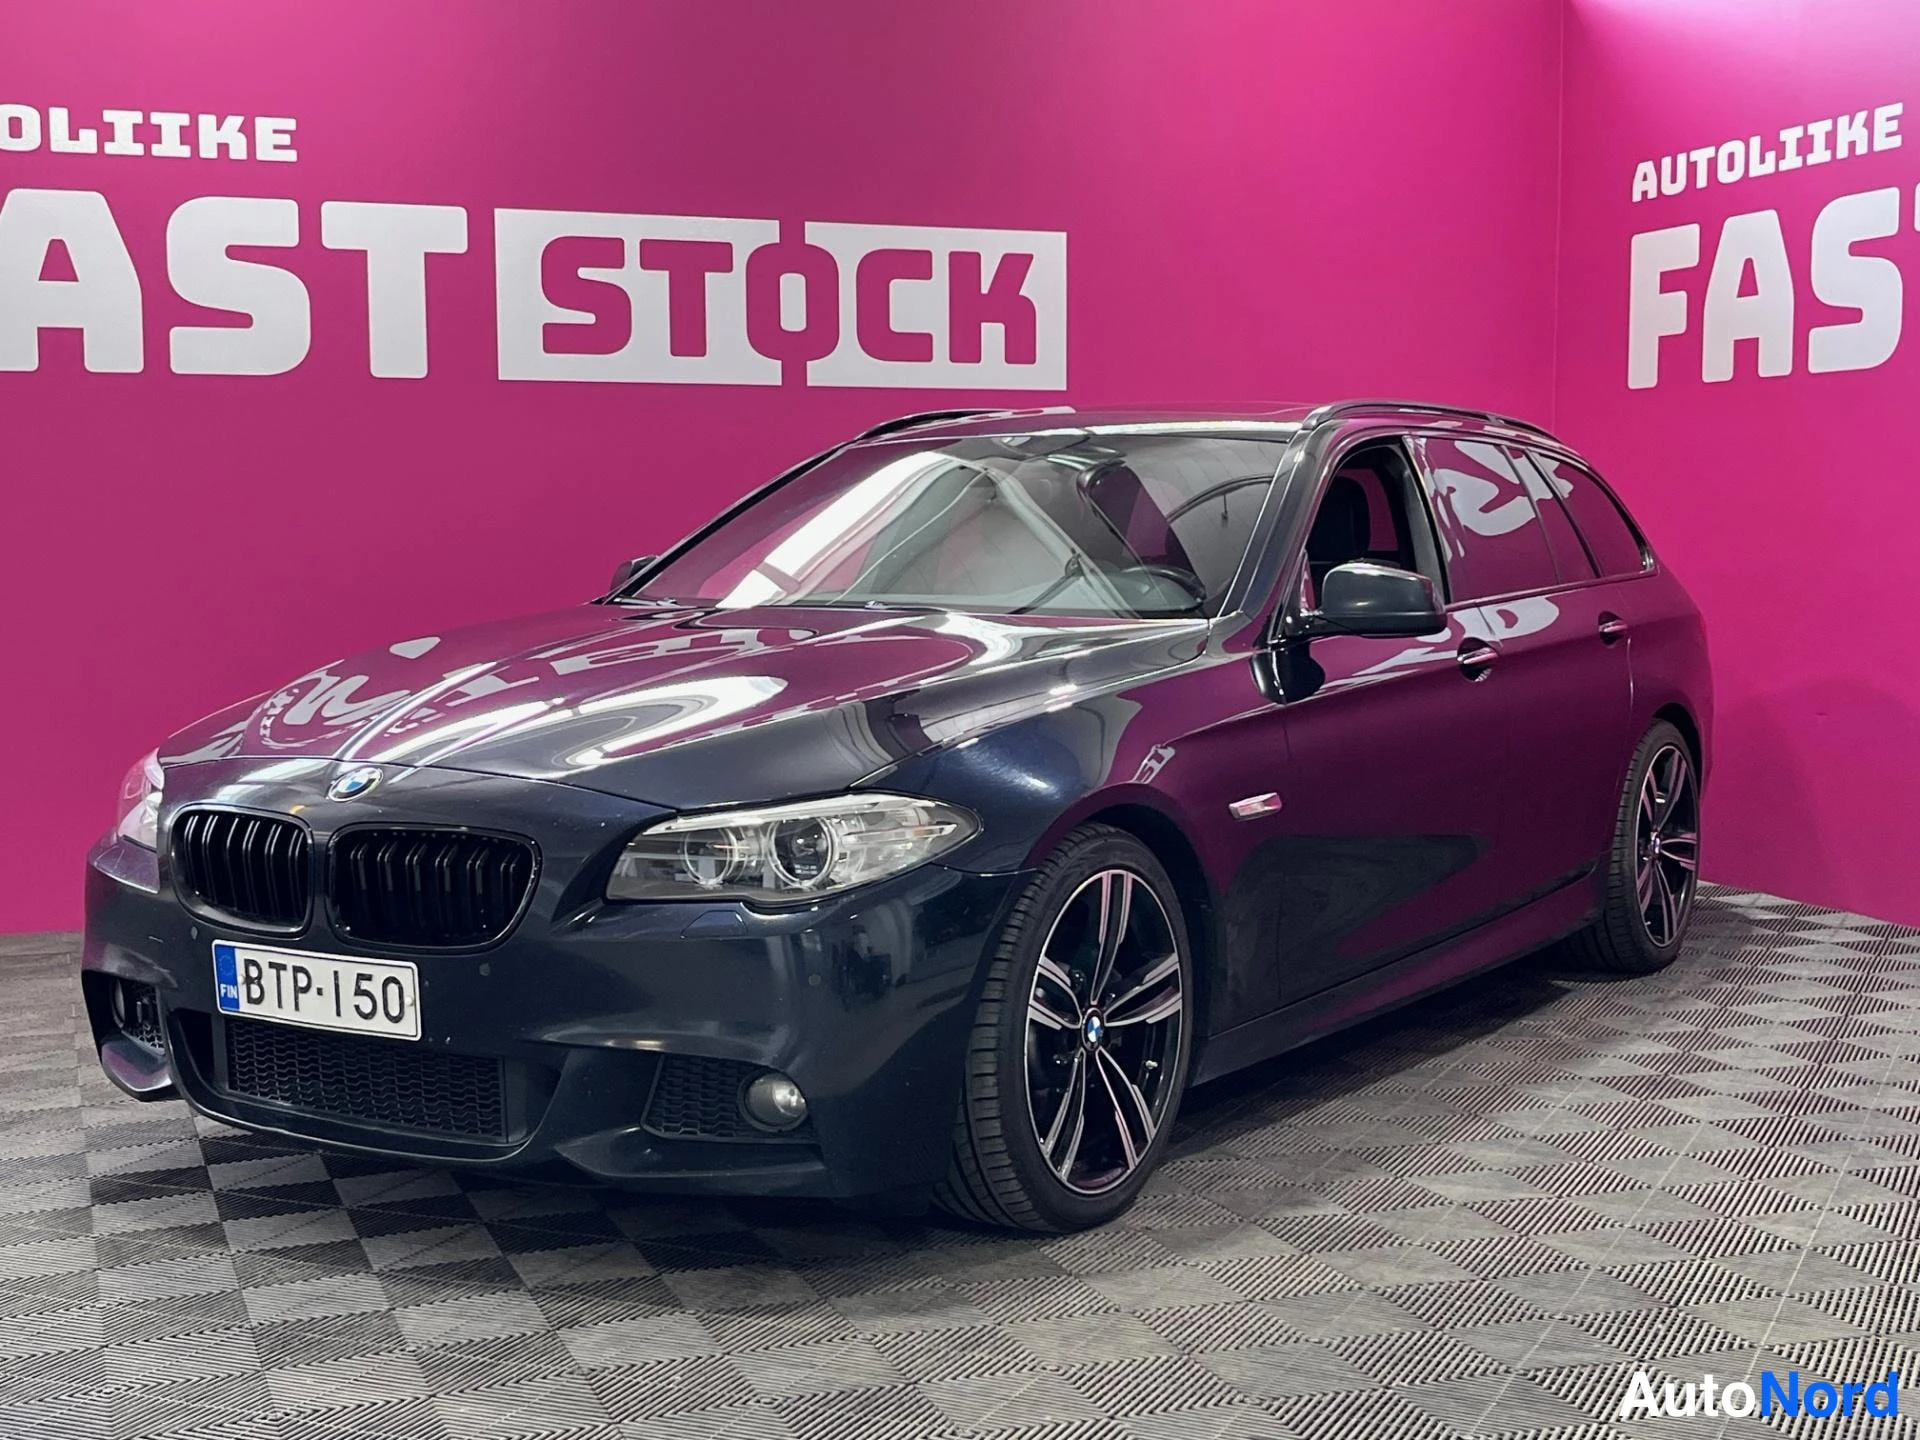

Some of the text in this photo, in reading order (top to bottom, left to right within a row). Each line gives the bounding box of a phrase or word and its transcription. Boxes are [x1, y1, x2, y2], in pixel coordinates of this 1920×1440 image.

[0, 103, 298, 162] OLIIKE
[1632, 102, 1904, 202] AUTOLIIKE
[541, 235, 1037, 365] STOCK
[1628, 182, 1920, 390] FAS
[220, 983, 238, 999] FIN
[243, 958, 406, 1024] BTP-150
